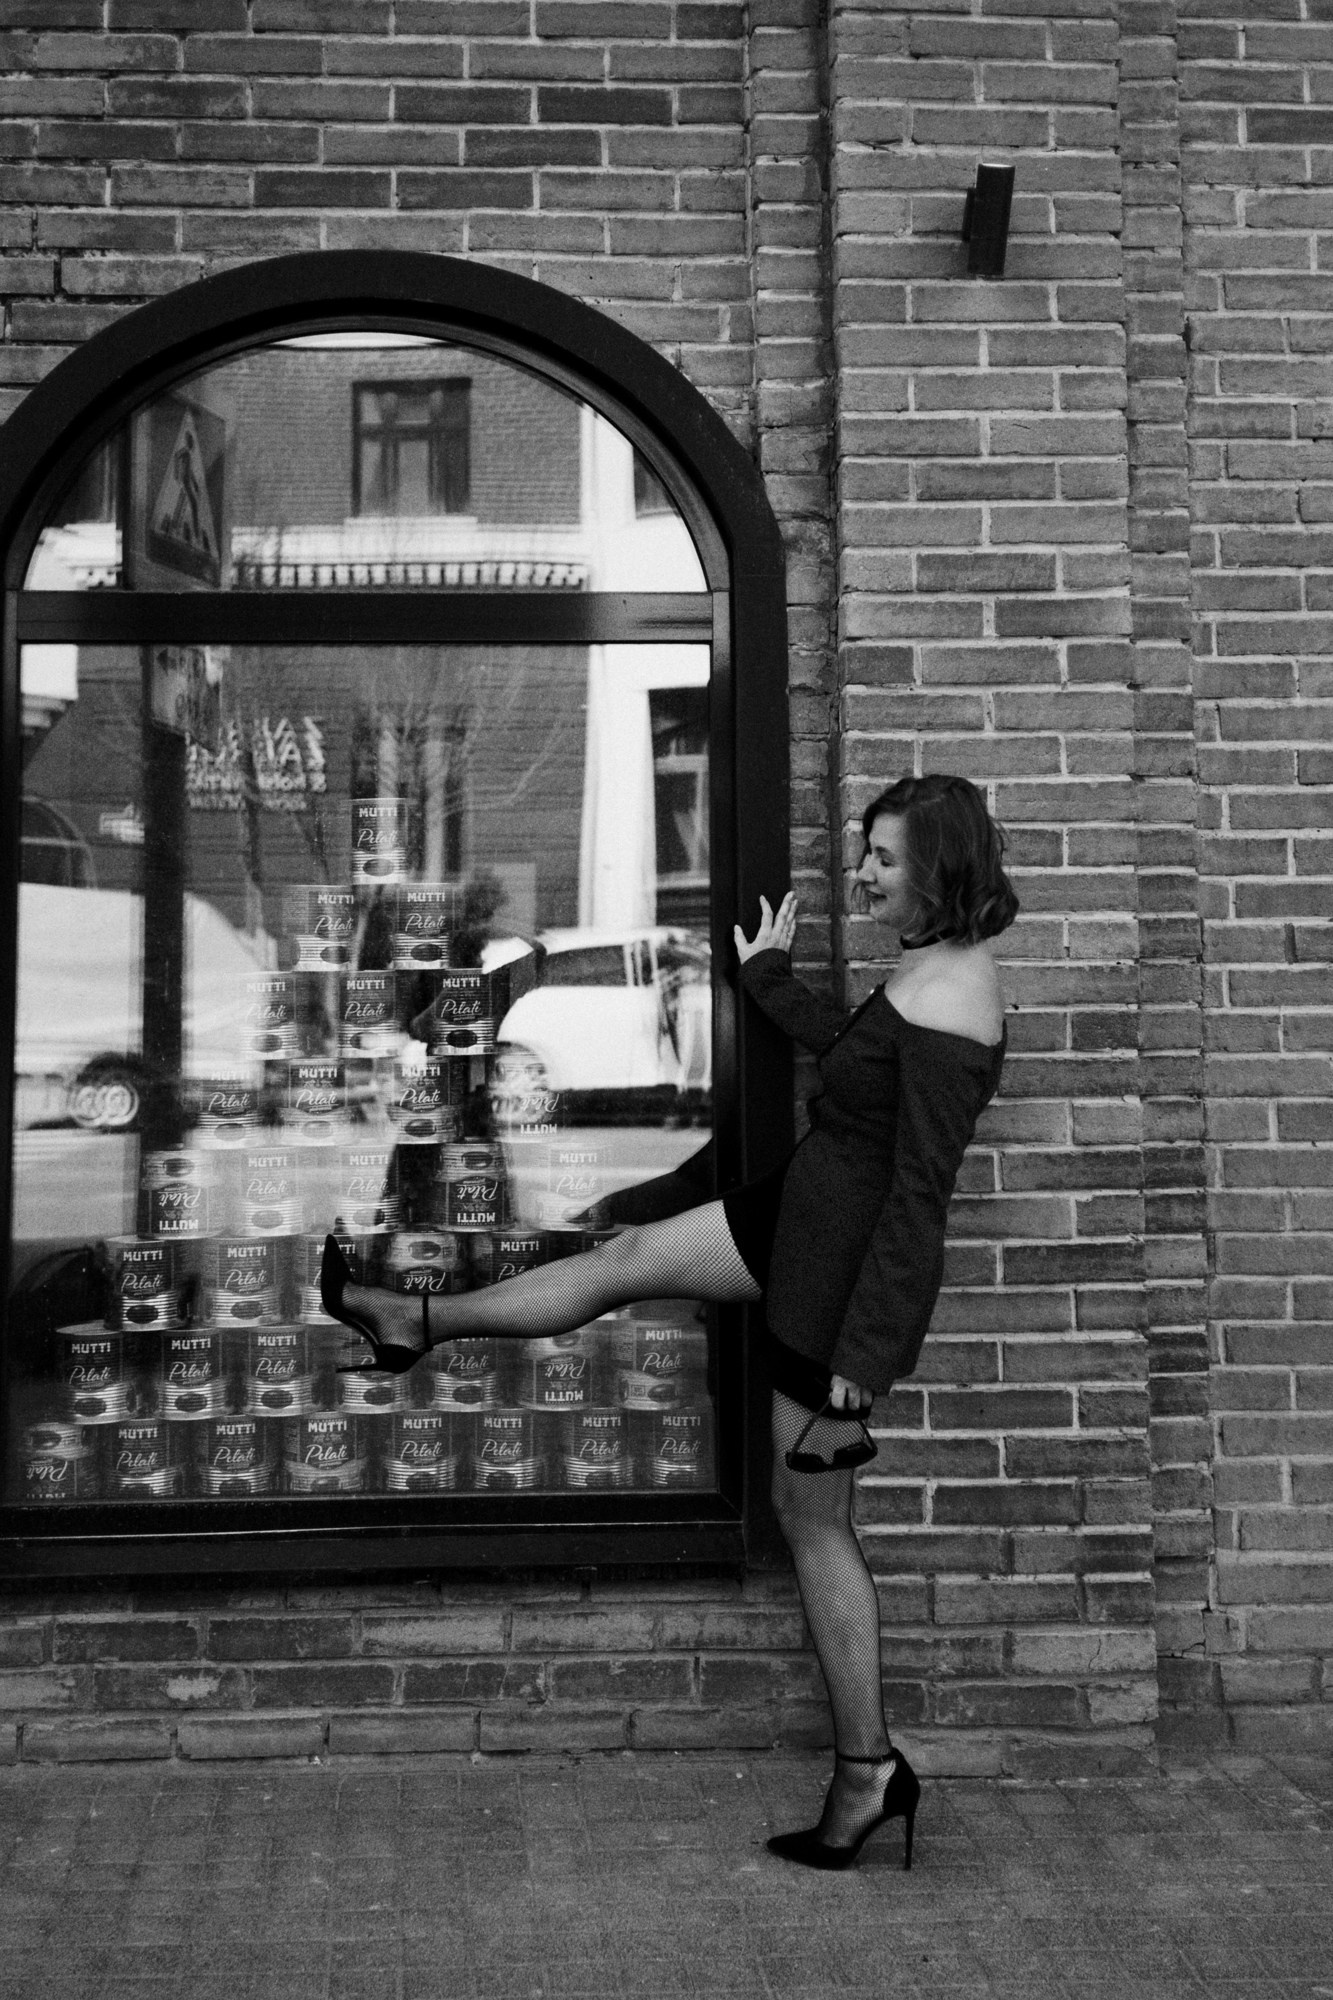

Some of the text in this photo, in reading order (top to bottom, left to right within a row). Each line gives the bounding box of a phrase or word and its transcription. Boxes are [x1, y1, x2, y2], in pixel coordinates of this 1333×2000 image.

[359, 807, 398, 818] MUTTI
[357, 828, 397, 846] Pelati
[317, 894, 354, 905] MUTTI
[407, 892, 445, 903] MUTTI
[315, 914, 353, 933] Pelati
[405, 913, 446, 931] Pelati
[247, 981, 286, 993] MUTTI
[346, 979, 385, 990] MUTTI
[442, 977, 481, 989] MUTTI
[246, 1001, 286, 1020] Pelati
[344, 1000, 386, 1020] Pelati
[440, 999, 481, 1018] Pelati
[299, 1067, 338, 1078] MUTTI
[401, 1066, 441, 1077] MUTTI
[208, 1091, 249, 1111] Pelati
[296, 1088, 338, 1108] Pelati
[400, 1088, 441, 1106] Pelati
[520, 1124, 558, 1134] MUTTI
[248, 1156, 287, 1167] MUTTI
[350, 1155, 389, 1166] MUTTI
[559, 1153, 597, 1163] MUTTI
[247, 1178, 288, 1197] Pelati
[347, 1176, 388, 1195] Pelati
[457, 1181, 498, 1201] Pelati
[556, 1175, 596, 1193] Pelati
[159, 1189, 200, 1208] Pelati
[159, 1220, 199, 1231] MUTTI
[457, 1212, 496, 1222] MUTTI
[227, 1246, 267, 1257] MUTTI
[316, 1244, 355, 1254] MTTI
[501, 1241, 539, 1252] MUTTI
[123, 1250, 163, 1262] MUTTI
[121, 1272, 163, 1292] Pelati
[225, 1269, 267, 1290] Pelati
[404, 1272, 446, 1292] Pelati
[171, 1338, 211, 1350] MUTTI
[257, 1335, 297, 1347] MUTTI
[645, 1329, 682, 1341] MUTTI
[72, 1342, 111, 1354] MUTTI
[255, 1358, 296, 1377] Pelati
[447, 1353, 489, 1372] Pelati
[545, 1354, 585, 1379] Pelati
[642, 1352, 682, 1371] Pelati
[69, 1366, 111, 1386] Pelati
[169, 1361, 211, 1381] Pelati
[545, 1390, 584, 1402] MUTTI
[216, 1423, 256, 1435] MUTTI
[308, 1420, 347, 1432] MUTTI
[403, 1417, 442, 1429] MUTTI
[483, 1417, 522, 1429] MUTTI
[583, 1416, 622, 1427] MUTTI
[662, 1415, 701, 1427] MUTTI
[118, 1427, 158, 1439] MUTTI
[305, 1444, 347, 1464] Pelati
[400, 1440, 442, 1459] Pelati
[481, 1438, 522, 1458] Pelati
[579, 1438, 620, 1457] Pelati
[660, 1437, 699, 1455] Pelati
[116, 1451, 158, 1470] Pelati
[213, 1446, 256, 1465] Pelati
[26, 1461, 68, 1482] Pelati
